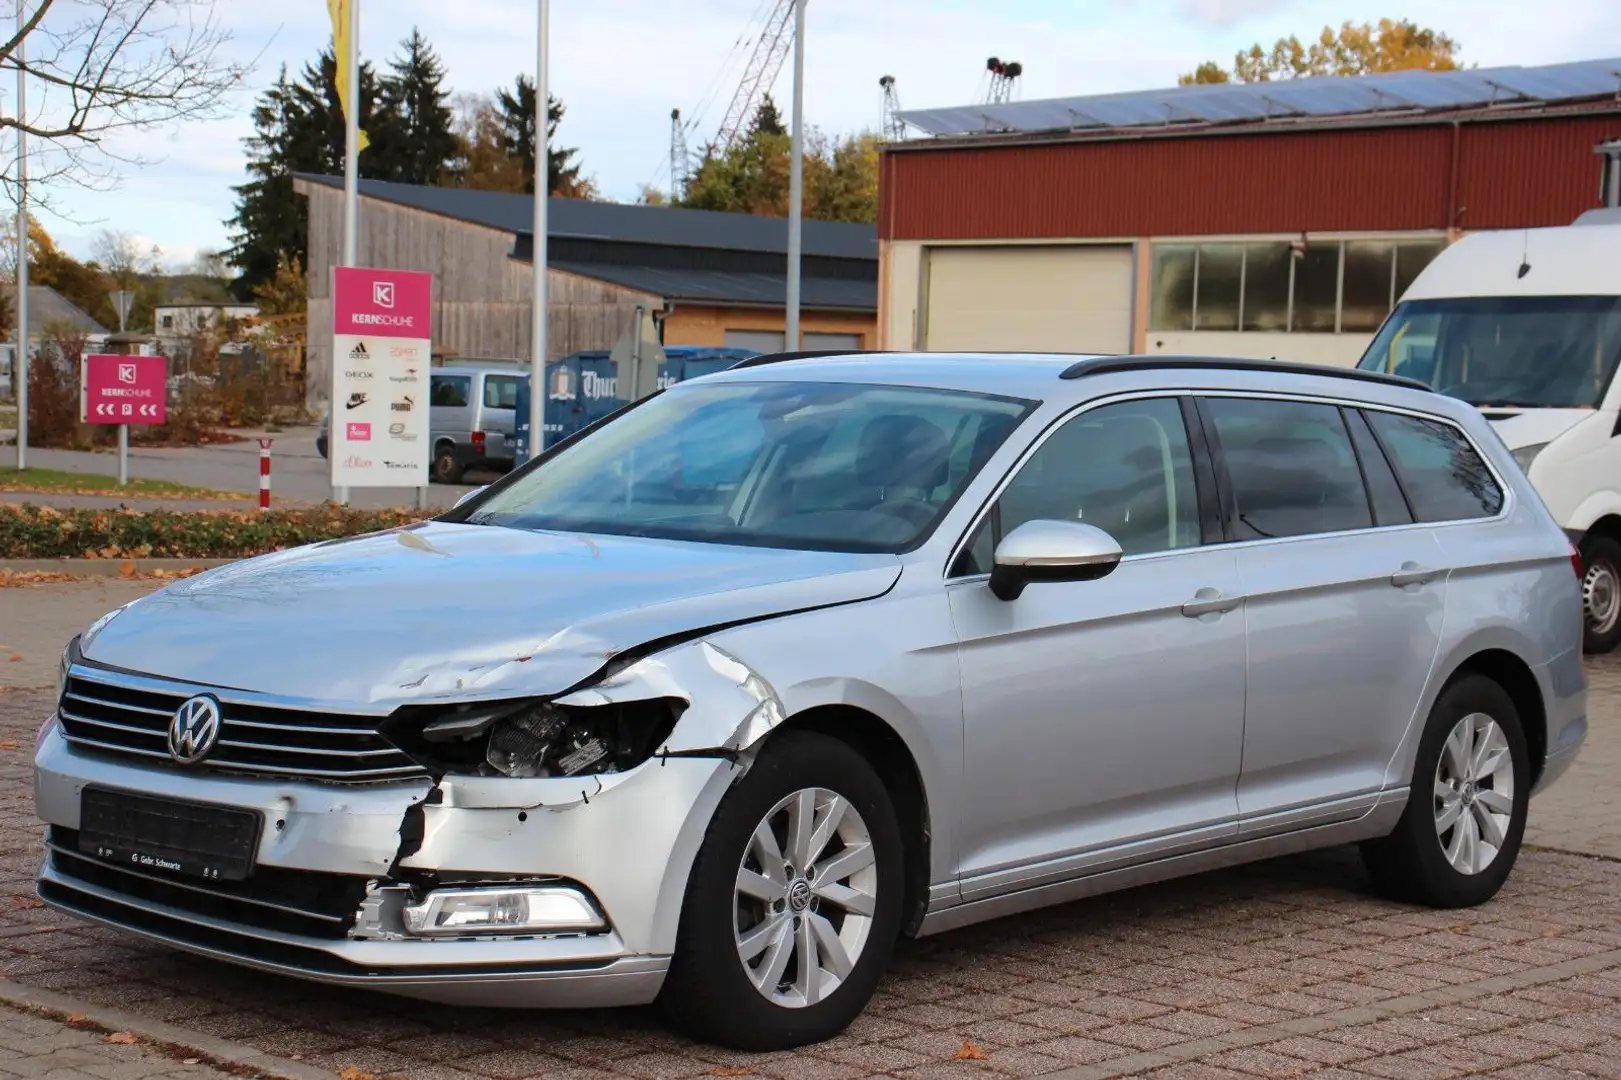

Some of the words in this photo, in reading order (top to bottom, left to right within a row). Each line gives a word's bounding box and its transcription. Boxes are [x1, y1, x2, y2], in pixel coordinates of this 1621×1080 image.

[351, 313, 414, 327] KERNSCHUHE
[350, 392, 367, 402] NIKE
[390, 402, 411, 412] PUMA
